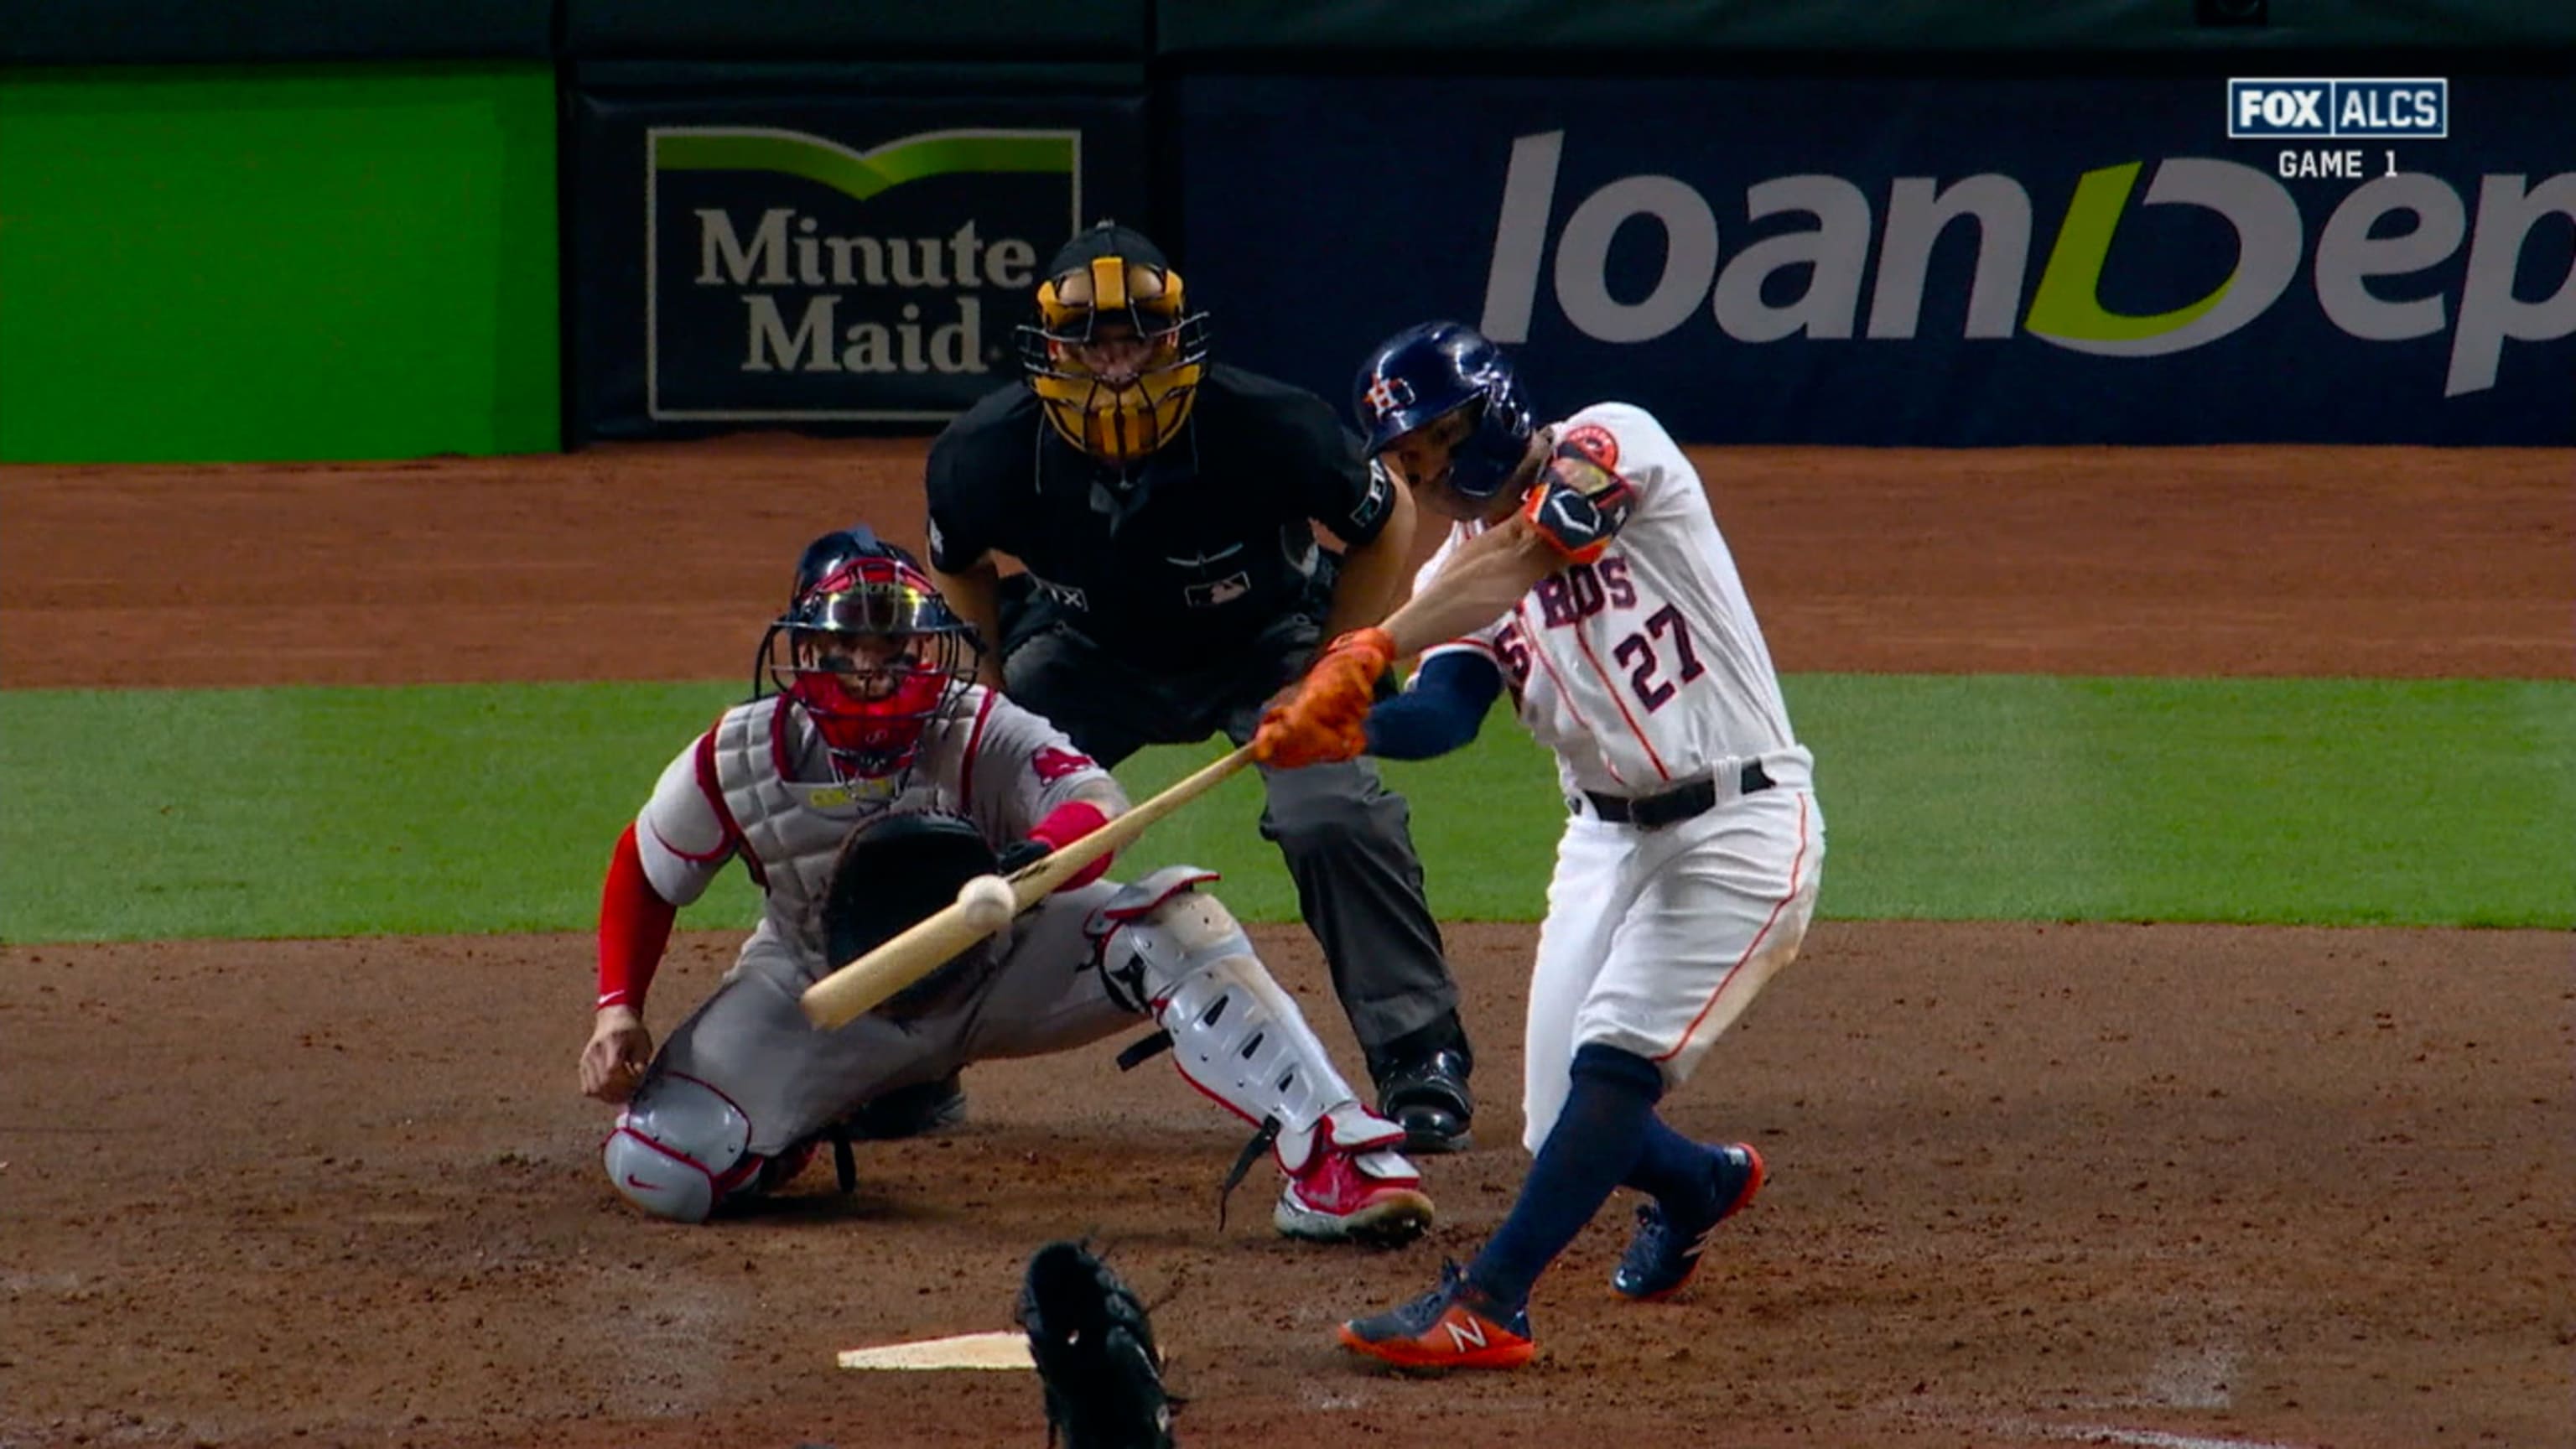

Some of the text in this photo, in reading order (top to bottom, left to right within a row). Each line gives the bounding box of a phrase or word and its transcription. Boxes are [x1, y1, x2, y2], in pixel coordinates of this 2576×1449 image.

[694, 208, 1036, 288] Minute
[740, 294, 989, 373] Maid
[1613, 602, 1706, 715] 27
[1444, 1314, 1486, 1353] N
